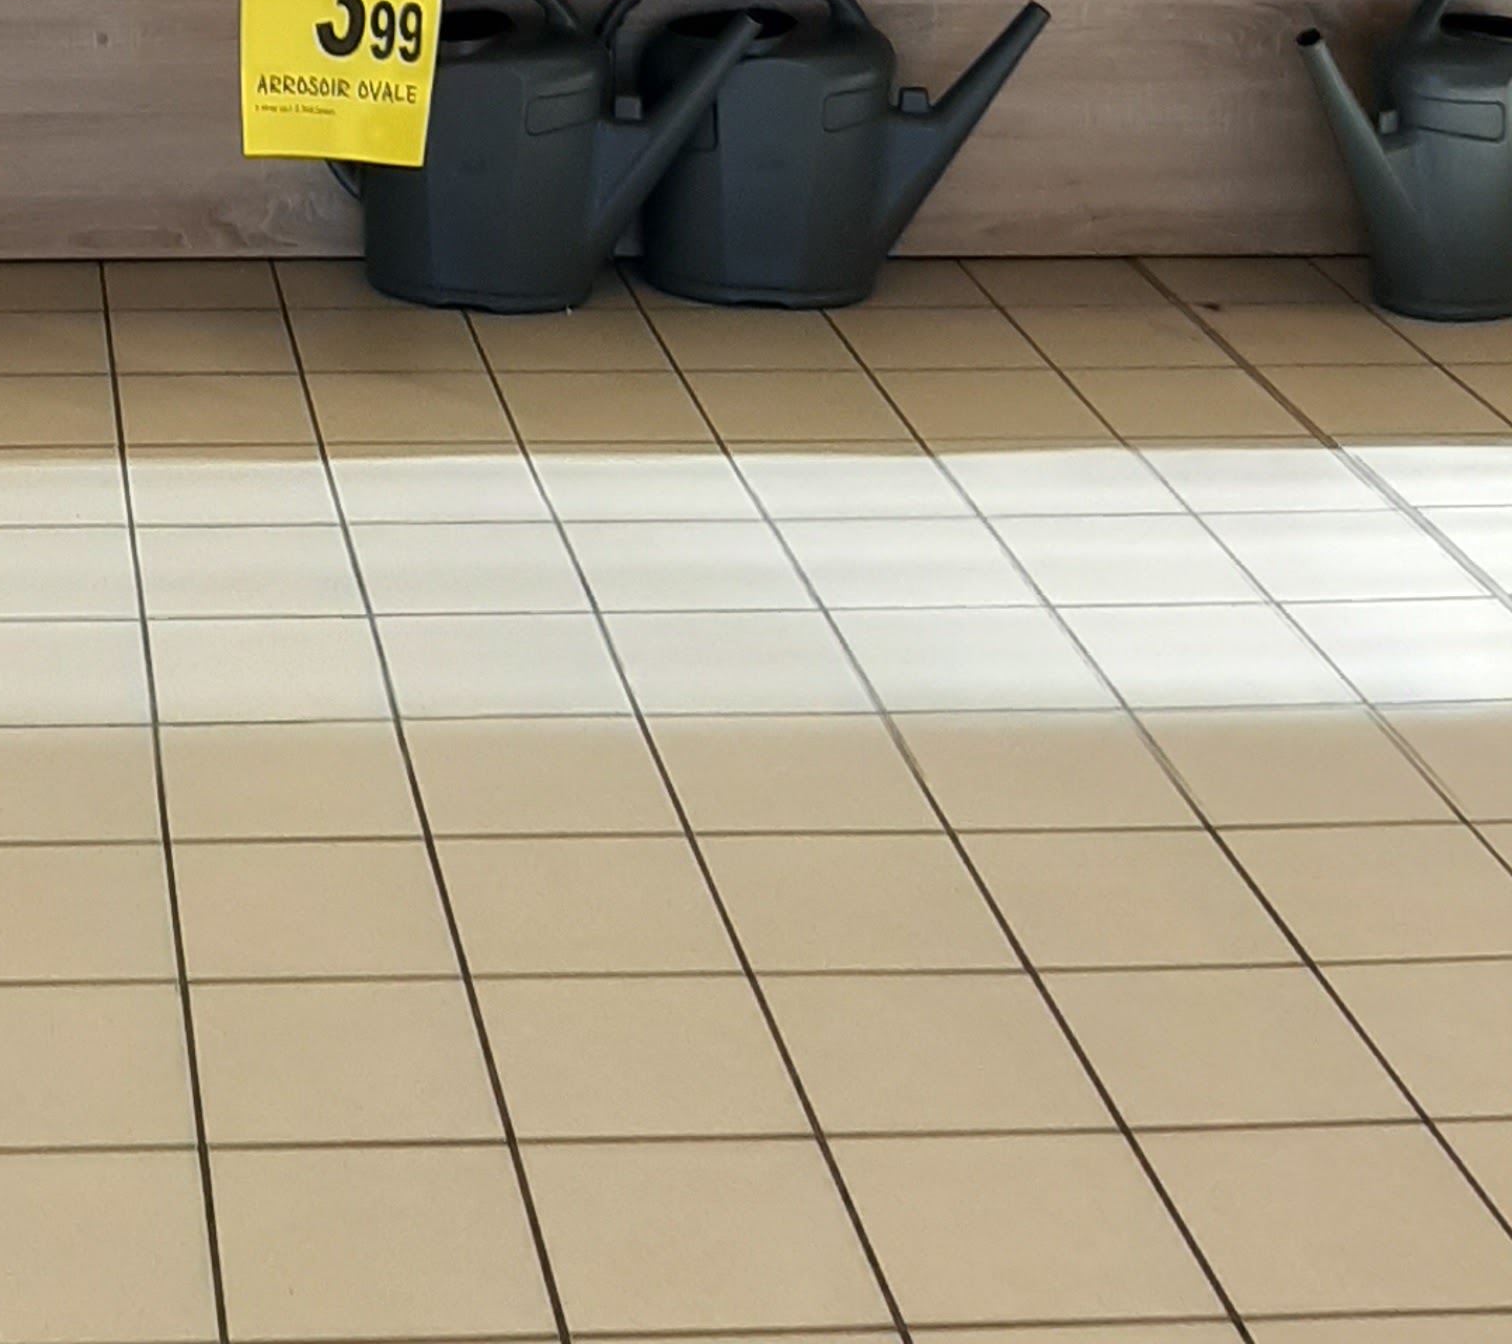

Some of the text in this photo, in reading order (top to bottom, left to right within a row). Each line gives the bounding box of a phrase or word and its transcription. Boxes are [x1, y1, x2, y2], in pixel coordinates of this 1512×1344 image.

[370, 0, 423, 62] 99
[257, 74, 417, 104] ARROSOIR OVALE
